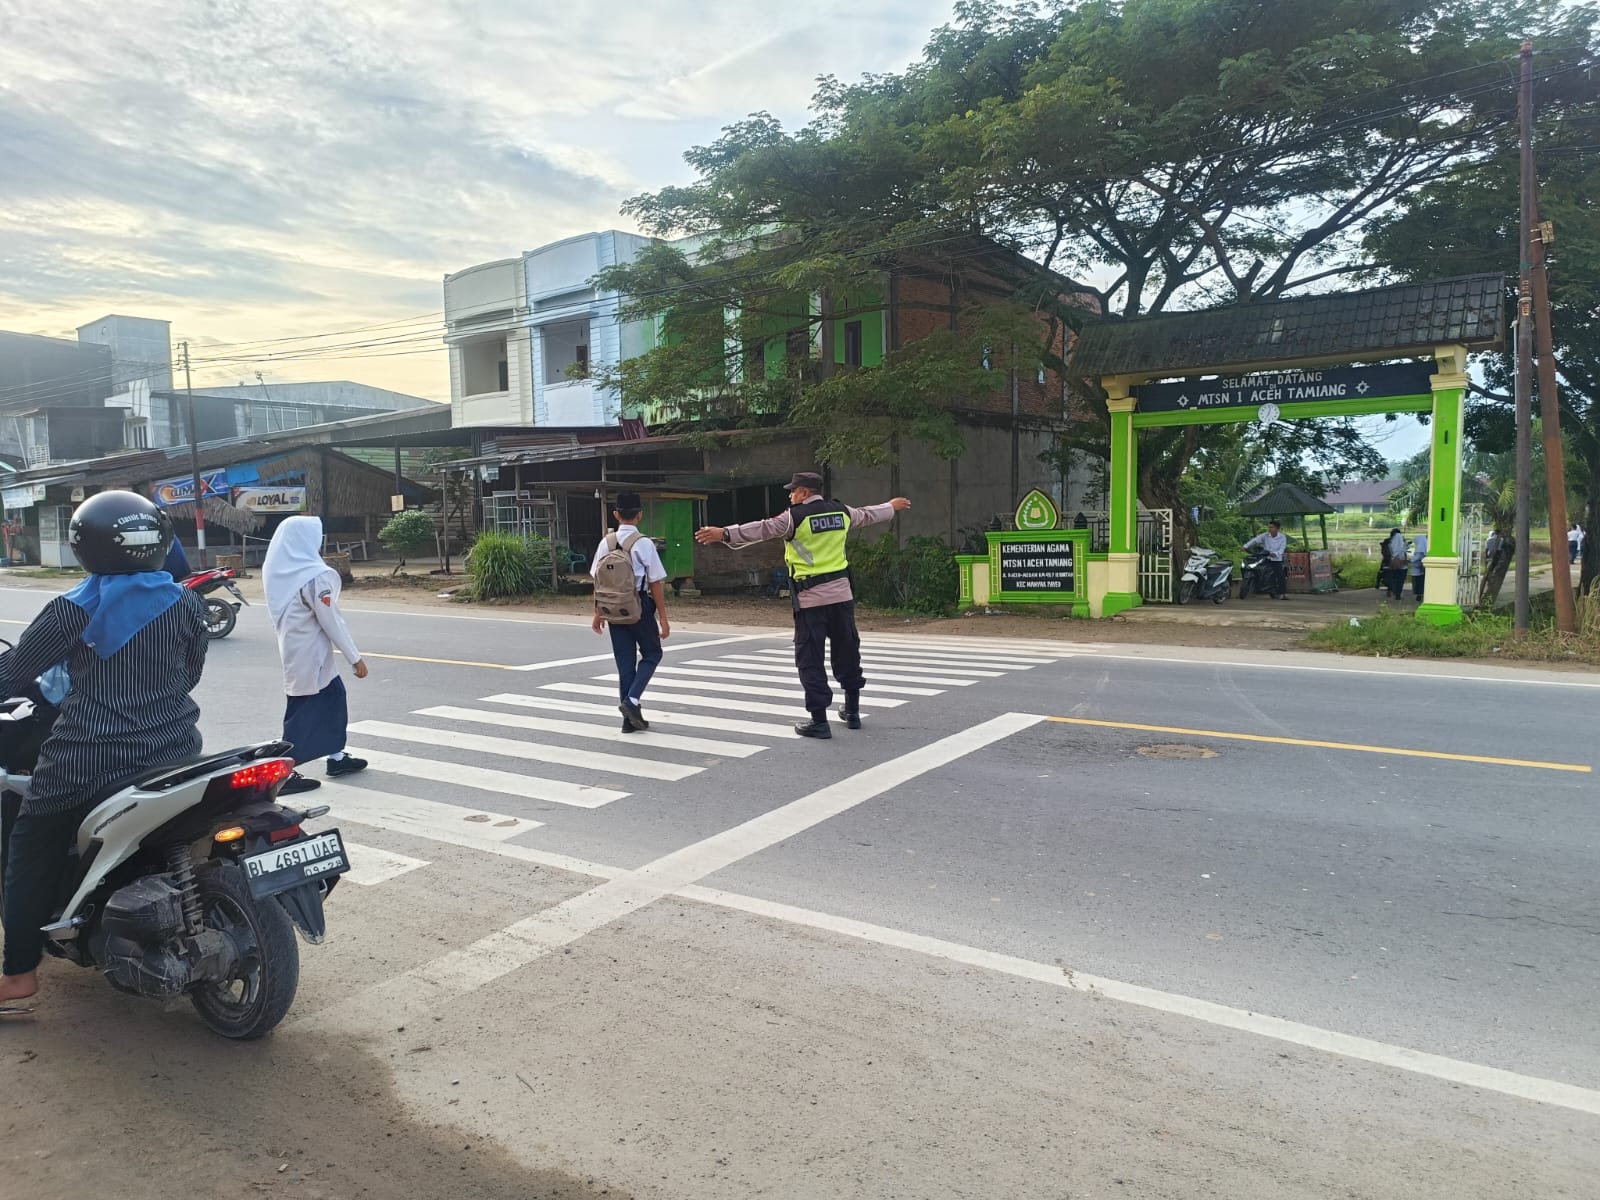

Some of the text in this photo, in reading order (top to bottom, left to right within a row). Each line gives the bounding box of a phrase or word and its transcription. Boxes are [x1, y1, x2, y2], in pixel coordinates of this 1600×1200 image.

[1222, 371, 1323, 389] SELAMAT DATANG
[1198, 383, 1347, 405] MTSN 1 ACEH TAMIANG
[257, 493, 289, 506] LOYAL
[810, 515, 844, 531] POLISI
[1002, 543, 1070, 554] KEMENTERIAN AGAMA
[1002, 558, 1073, 568] MTSN 1 ACEH TAMIANG
[248, 859, 269, 878] BL
[275, 847, 308, 870] 4691
